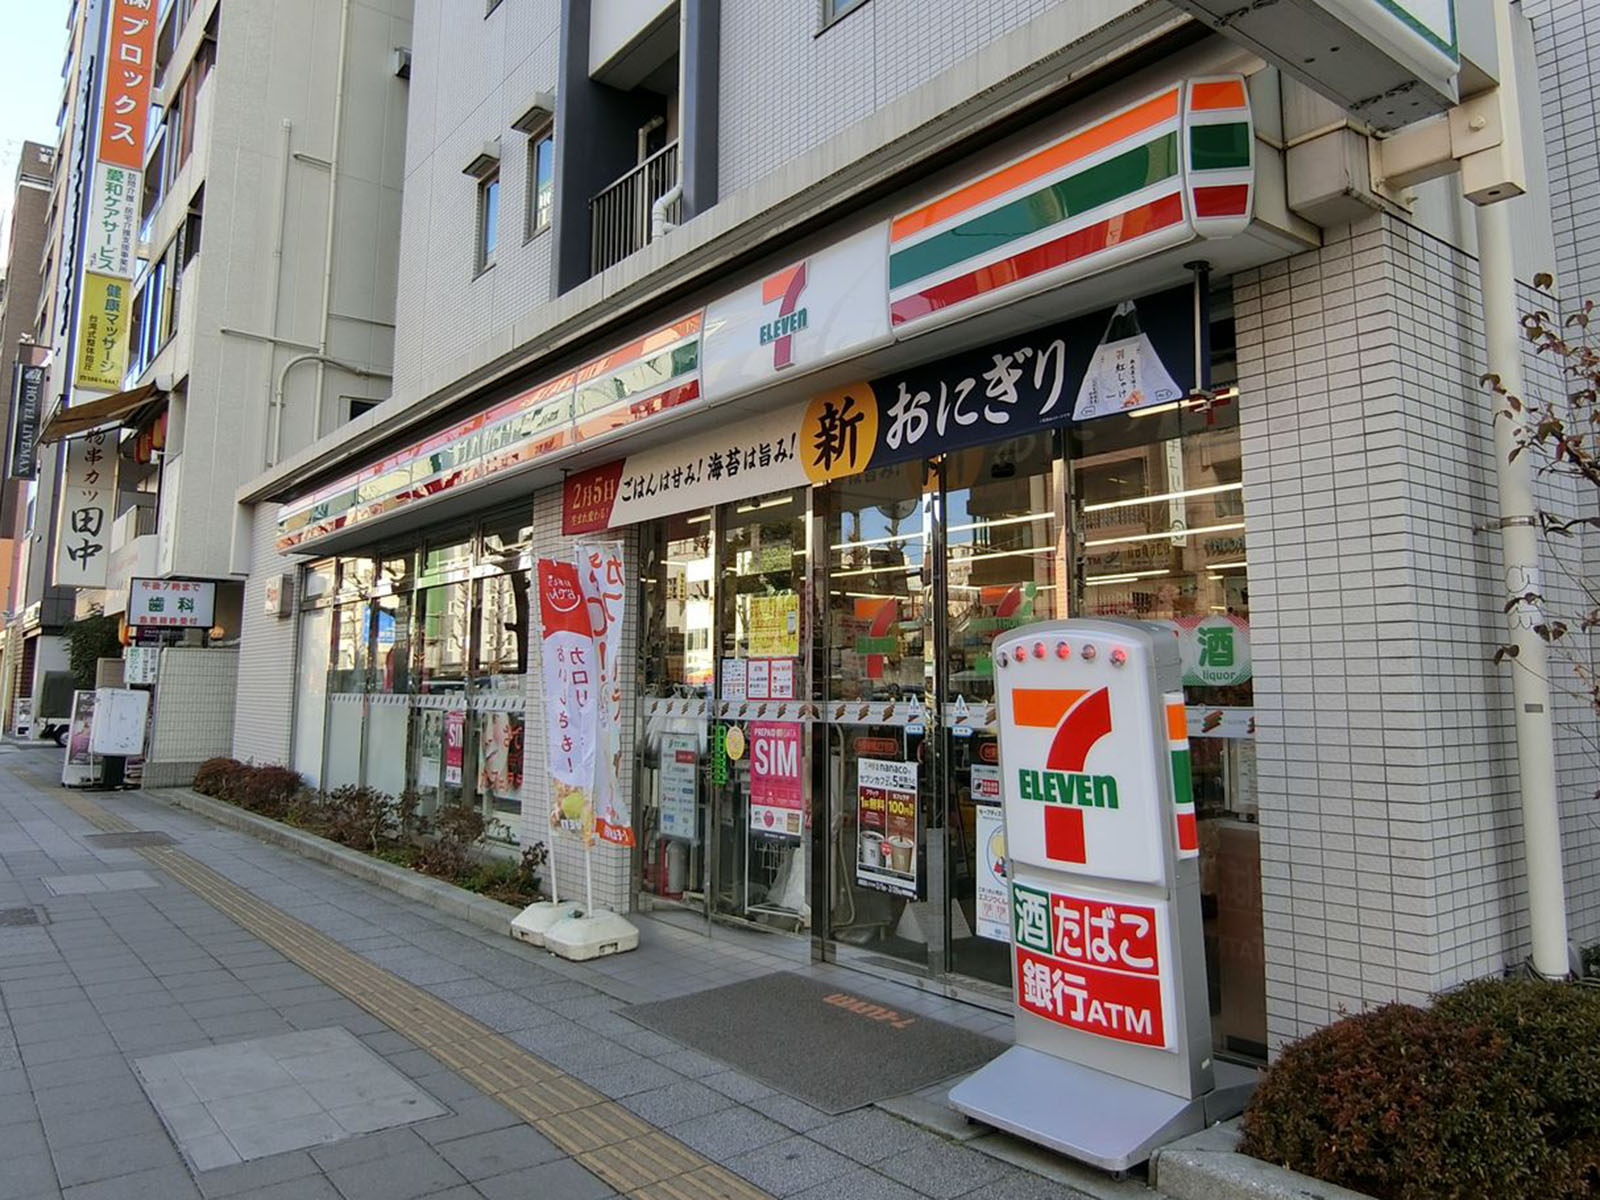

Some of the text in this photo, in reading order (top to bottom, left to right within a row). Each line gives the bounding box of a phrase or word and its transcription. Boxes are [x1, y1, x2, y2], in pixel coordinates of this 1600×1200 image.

[100, 284, 122, 373] 健康マッサージ
[18, 383, 38, 474] HOTEL LIVEMAX
[886, 339, 1066, 450] おにぎり
[622, 432, 797, 502] ごはんは甘み! 海苔は旨み!
[813, 396, 864, 471] 新
[572, 476, 615, 509] 2月5日
[142, 581, 201, 592] 午後7時まで
[148, 596, 195, 613] 歯科
[1197, 626, 1235, 667] 酒
[1202, 670, 1236, 681] liquor
[754, 738, 799, 778] SIM
[1015, 887, 1154, 968] 酒 たばこ
[1023, 958, 1153, 1036] 銀行ATM
